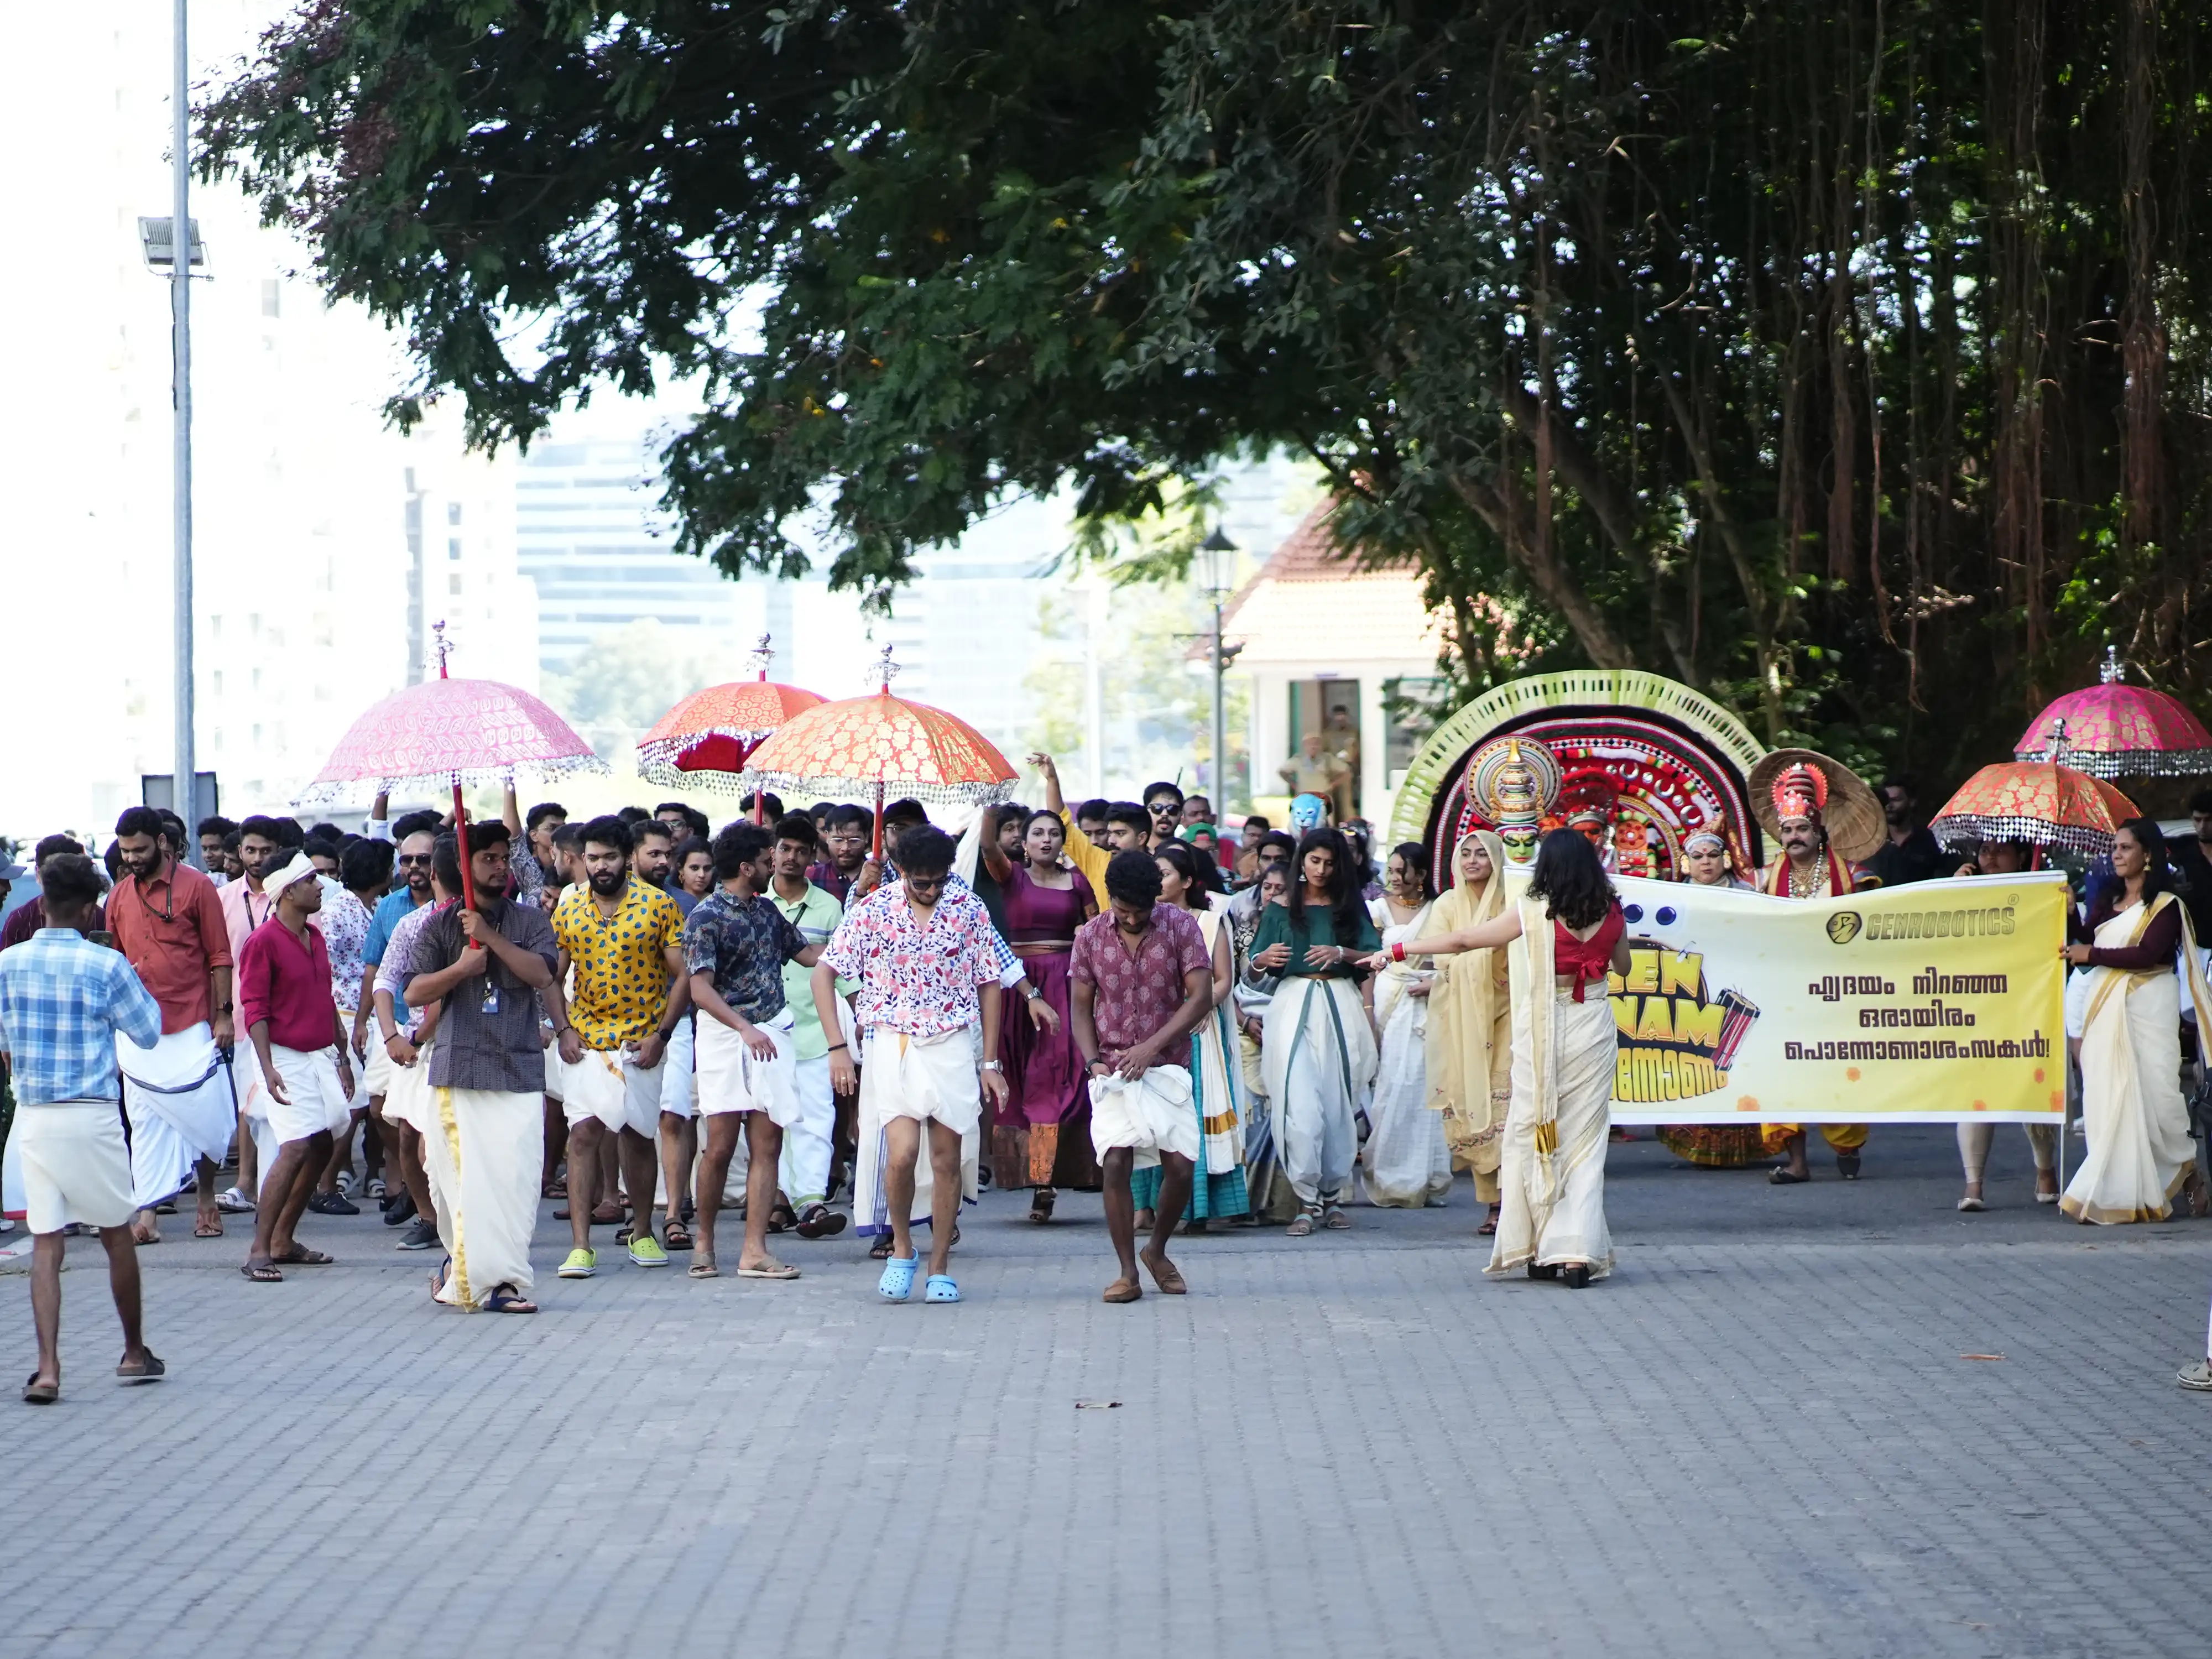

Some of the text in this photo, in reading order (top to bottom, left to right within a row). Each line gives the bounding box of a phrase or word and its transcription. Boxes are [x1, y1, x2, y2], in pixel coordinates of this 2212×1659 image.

[1866, 907, 2015, 940] GENROBOTICS
[1809, 967, 2007, 1001] ഹൃദയം നിറഞ്ഞ
[1607, 996, 1726, 1048] NAM
[1859, 999, 1975, 1027] ഒരായിരം
